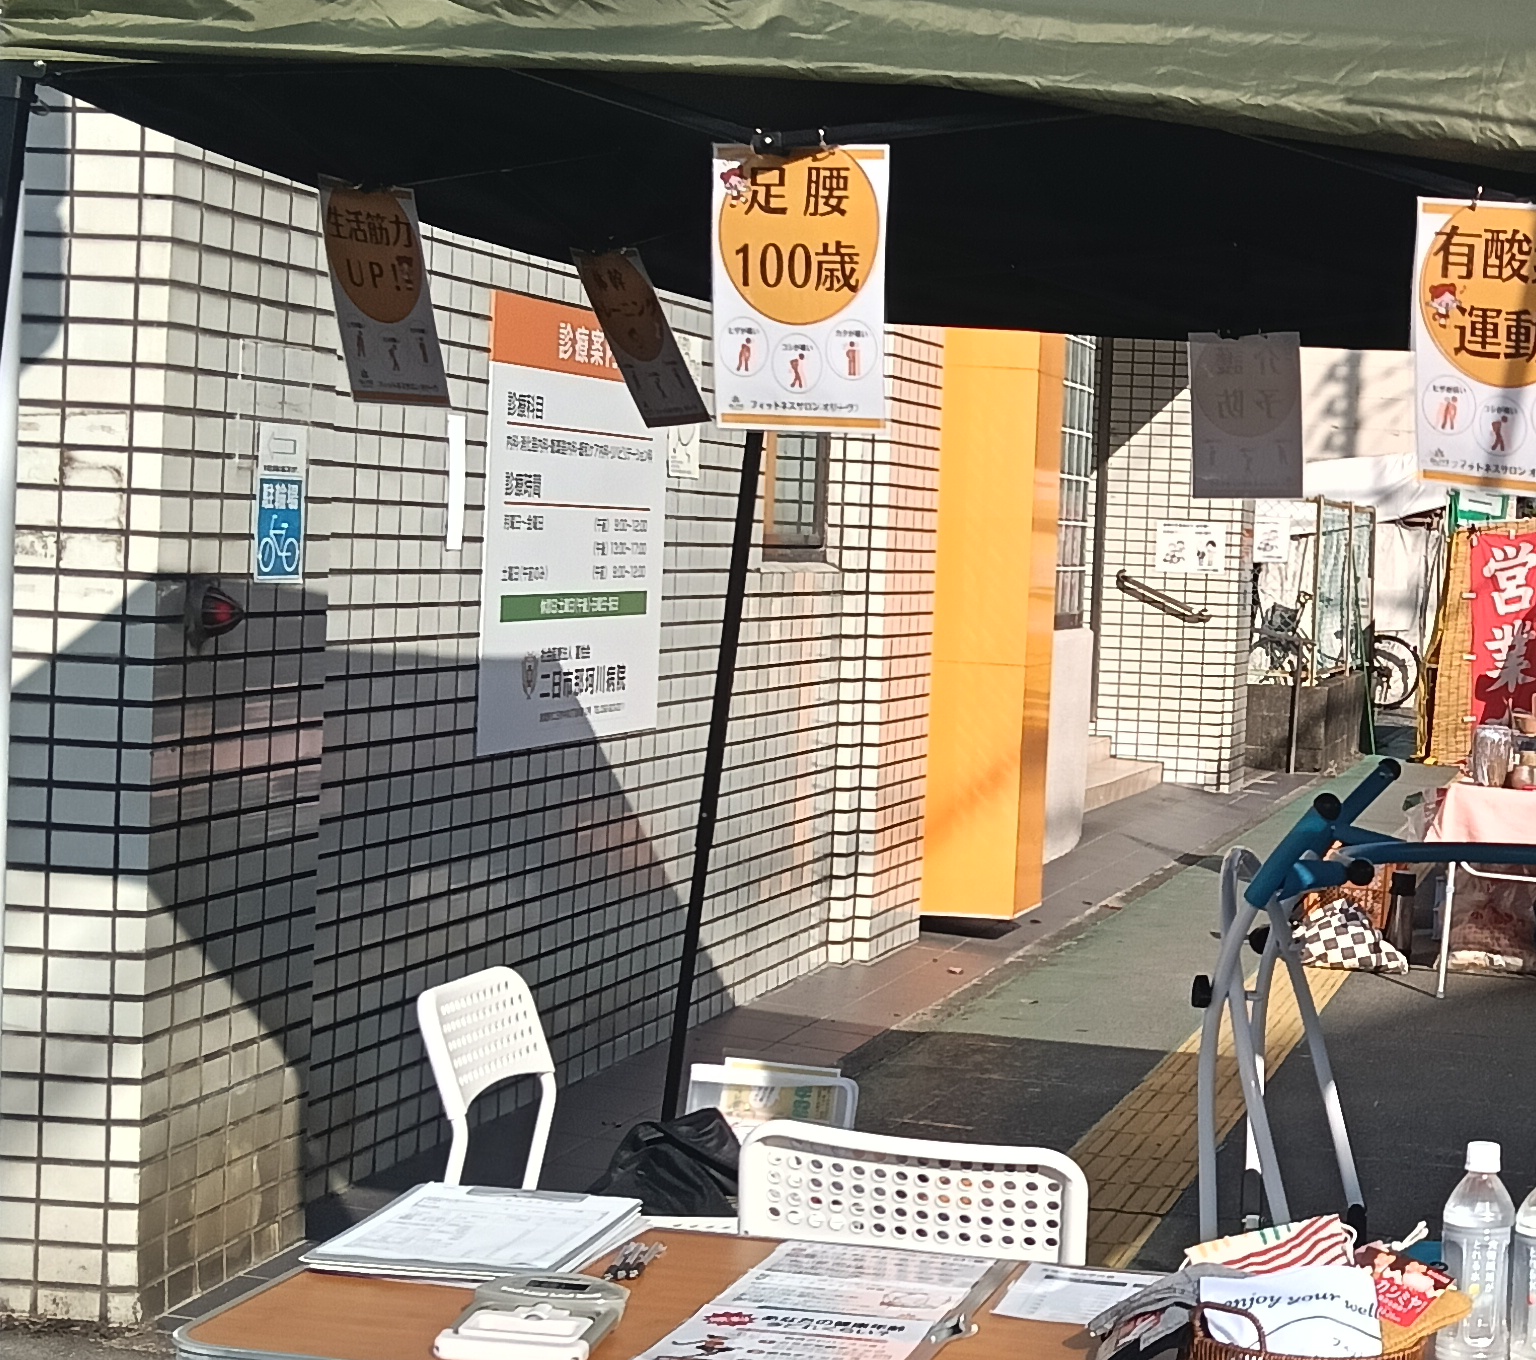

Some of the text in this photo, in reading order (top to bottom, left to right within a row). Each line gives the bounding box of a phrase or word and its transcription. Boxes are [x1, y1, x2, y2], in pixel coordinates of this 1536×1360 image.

[745, 166, 850, 217] 足腰
[327, 206, 414, 249] 生活筋力
[734, 240, 861, 292] 100歳
[1286, 1292, 1342, 1311] your
